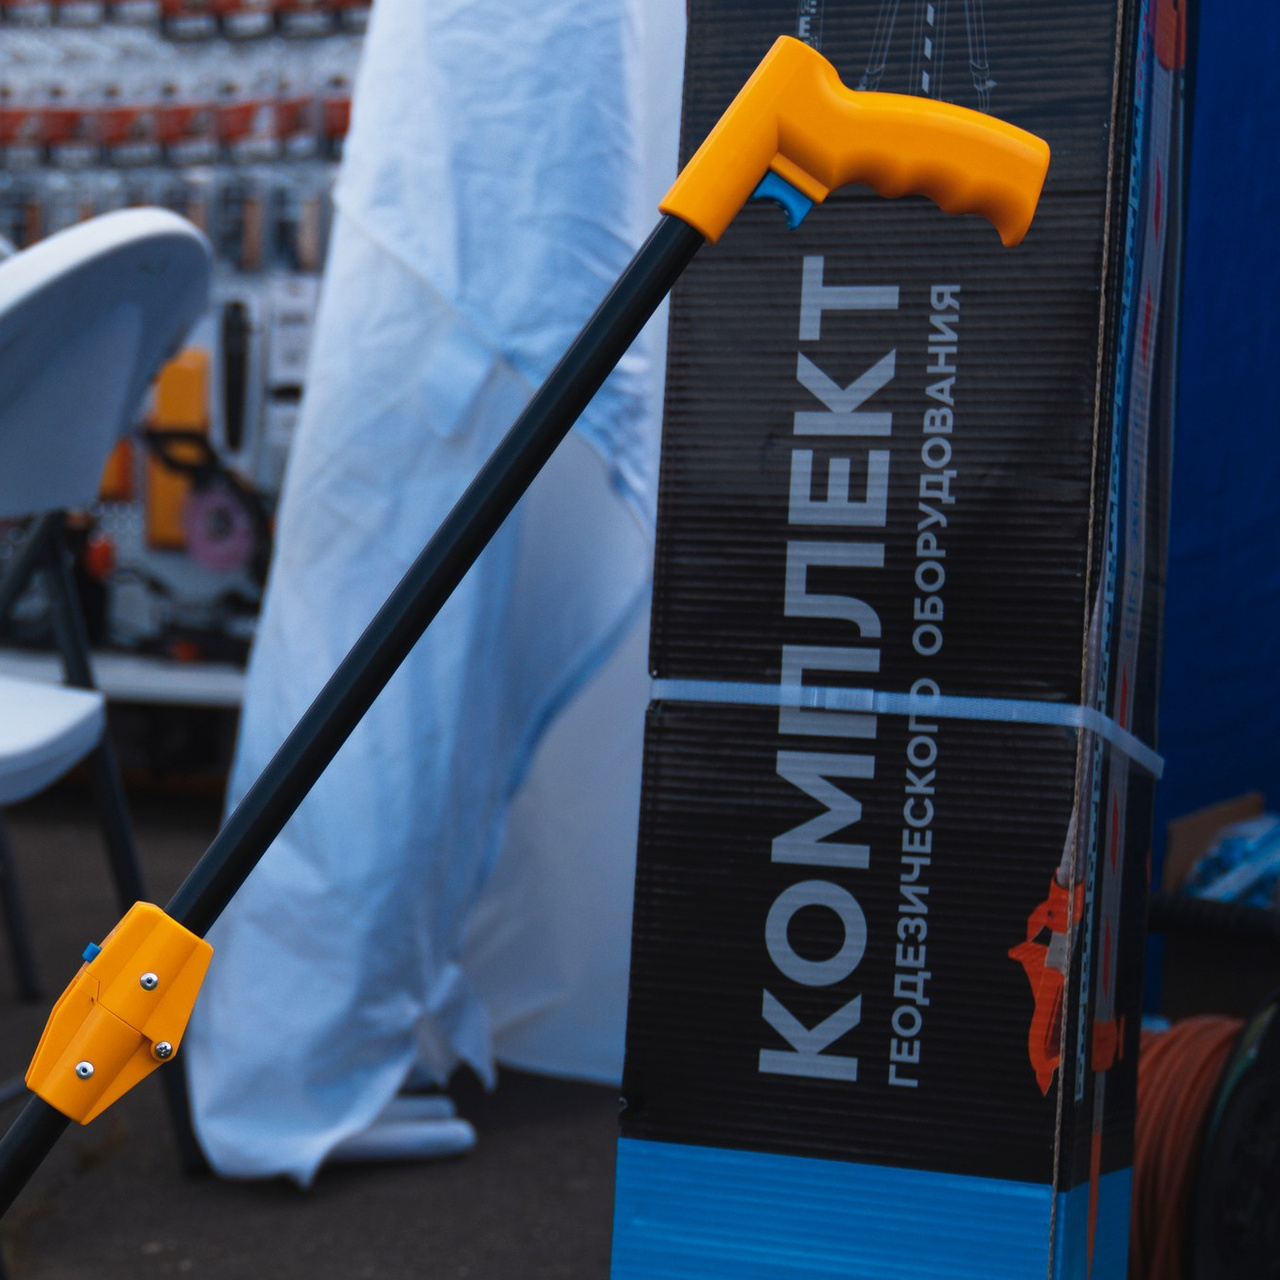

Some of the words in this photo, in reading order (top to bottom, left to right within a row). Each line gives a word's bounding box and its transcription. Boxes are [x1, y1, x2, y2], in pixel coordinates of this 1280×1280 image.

[757, 254, 902, 1084] КОМПЛЕКТ
[911, 283, 962, 654] ОБОРУДОВАНИЯ
[888, 677, 942, 1089] ГЕОДЕЗИЧЕСКОГО
